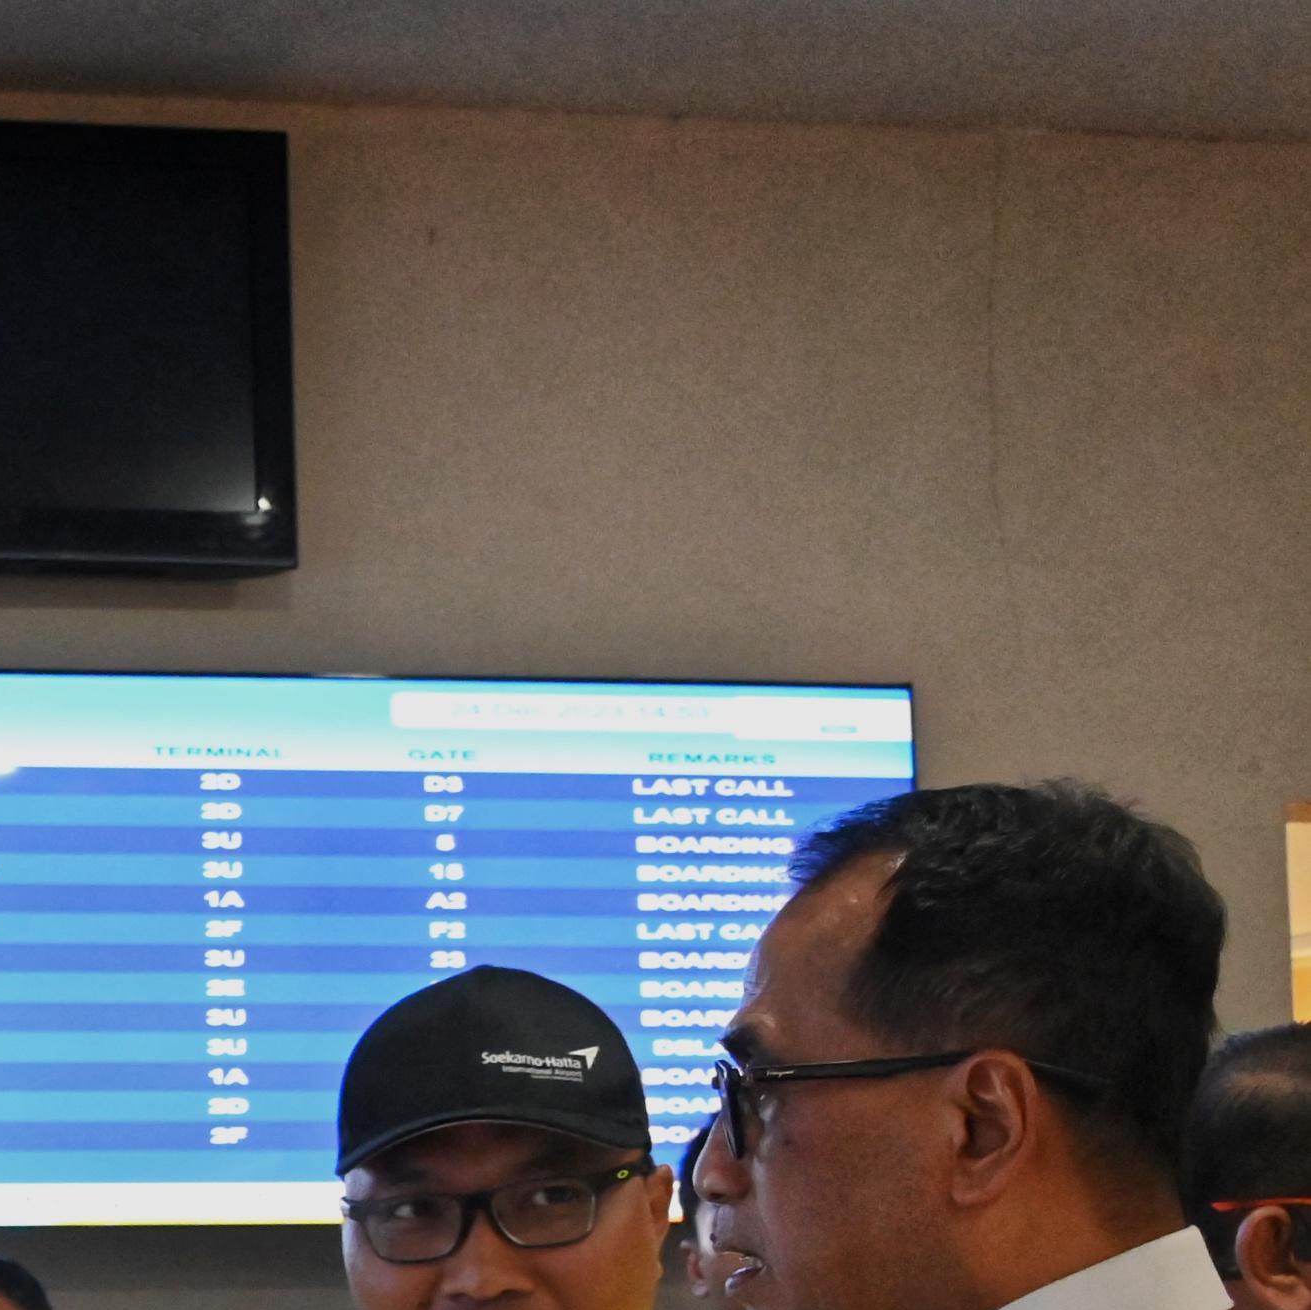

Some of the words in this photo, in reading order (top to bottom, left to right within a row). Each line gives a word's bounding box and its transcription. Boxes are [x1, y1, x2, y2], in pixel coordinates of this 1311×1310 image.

[153, 744, 285, 760] TERMINAL
[407, 748, 478, 762] GATE
[647, 751, 778, 766] REMARKS
[633, 779, 709, 795] LAST
[715, 780, 794, 796] CALL
[425, 805, 463, 821] D7
[634, 808, 710, 824] LAST
[717, 809, 794, 825] CALL
[636, 836, 794, 854] BOARDING
[205, 891, 244, 907] 1A
[427, 893, 466, 909] A2
[637, 924, 714, 940] LAST
[720, 924, 764, 940] CA
[639, 952, 751, 969] BOARD
[641, 981, 744, 998] BOARD
[481, 1051, 583, 1069] Soekarno-Hatta
[209, 1068, 248, 1084] 1A
